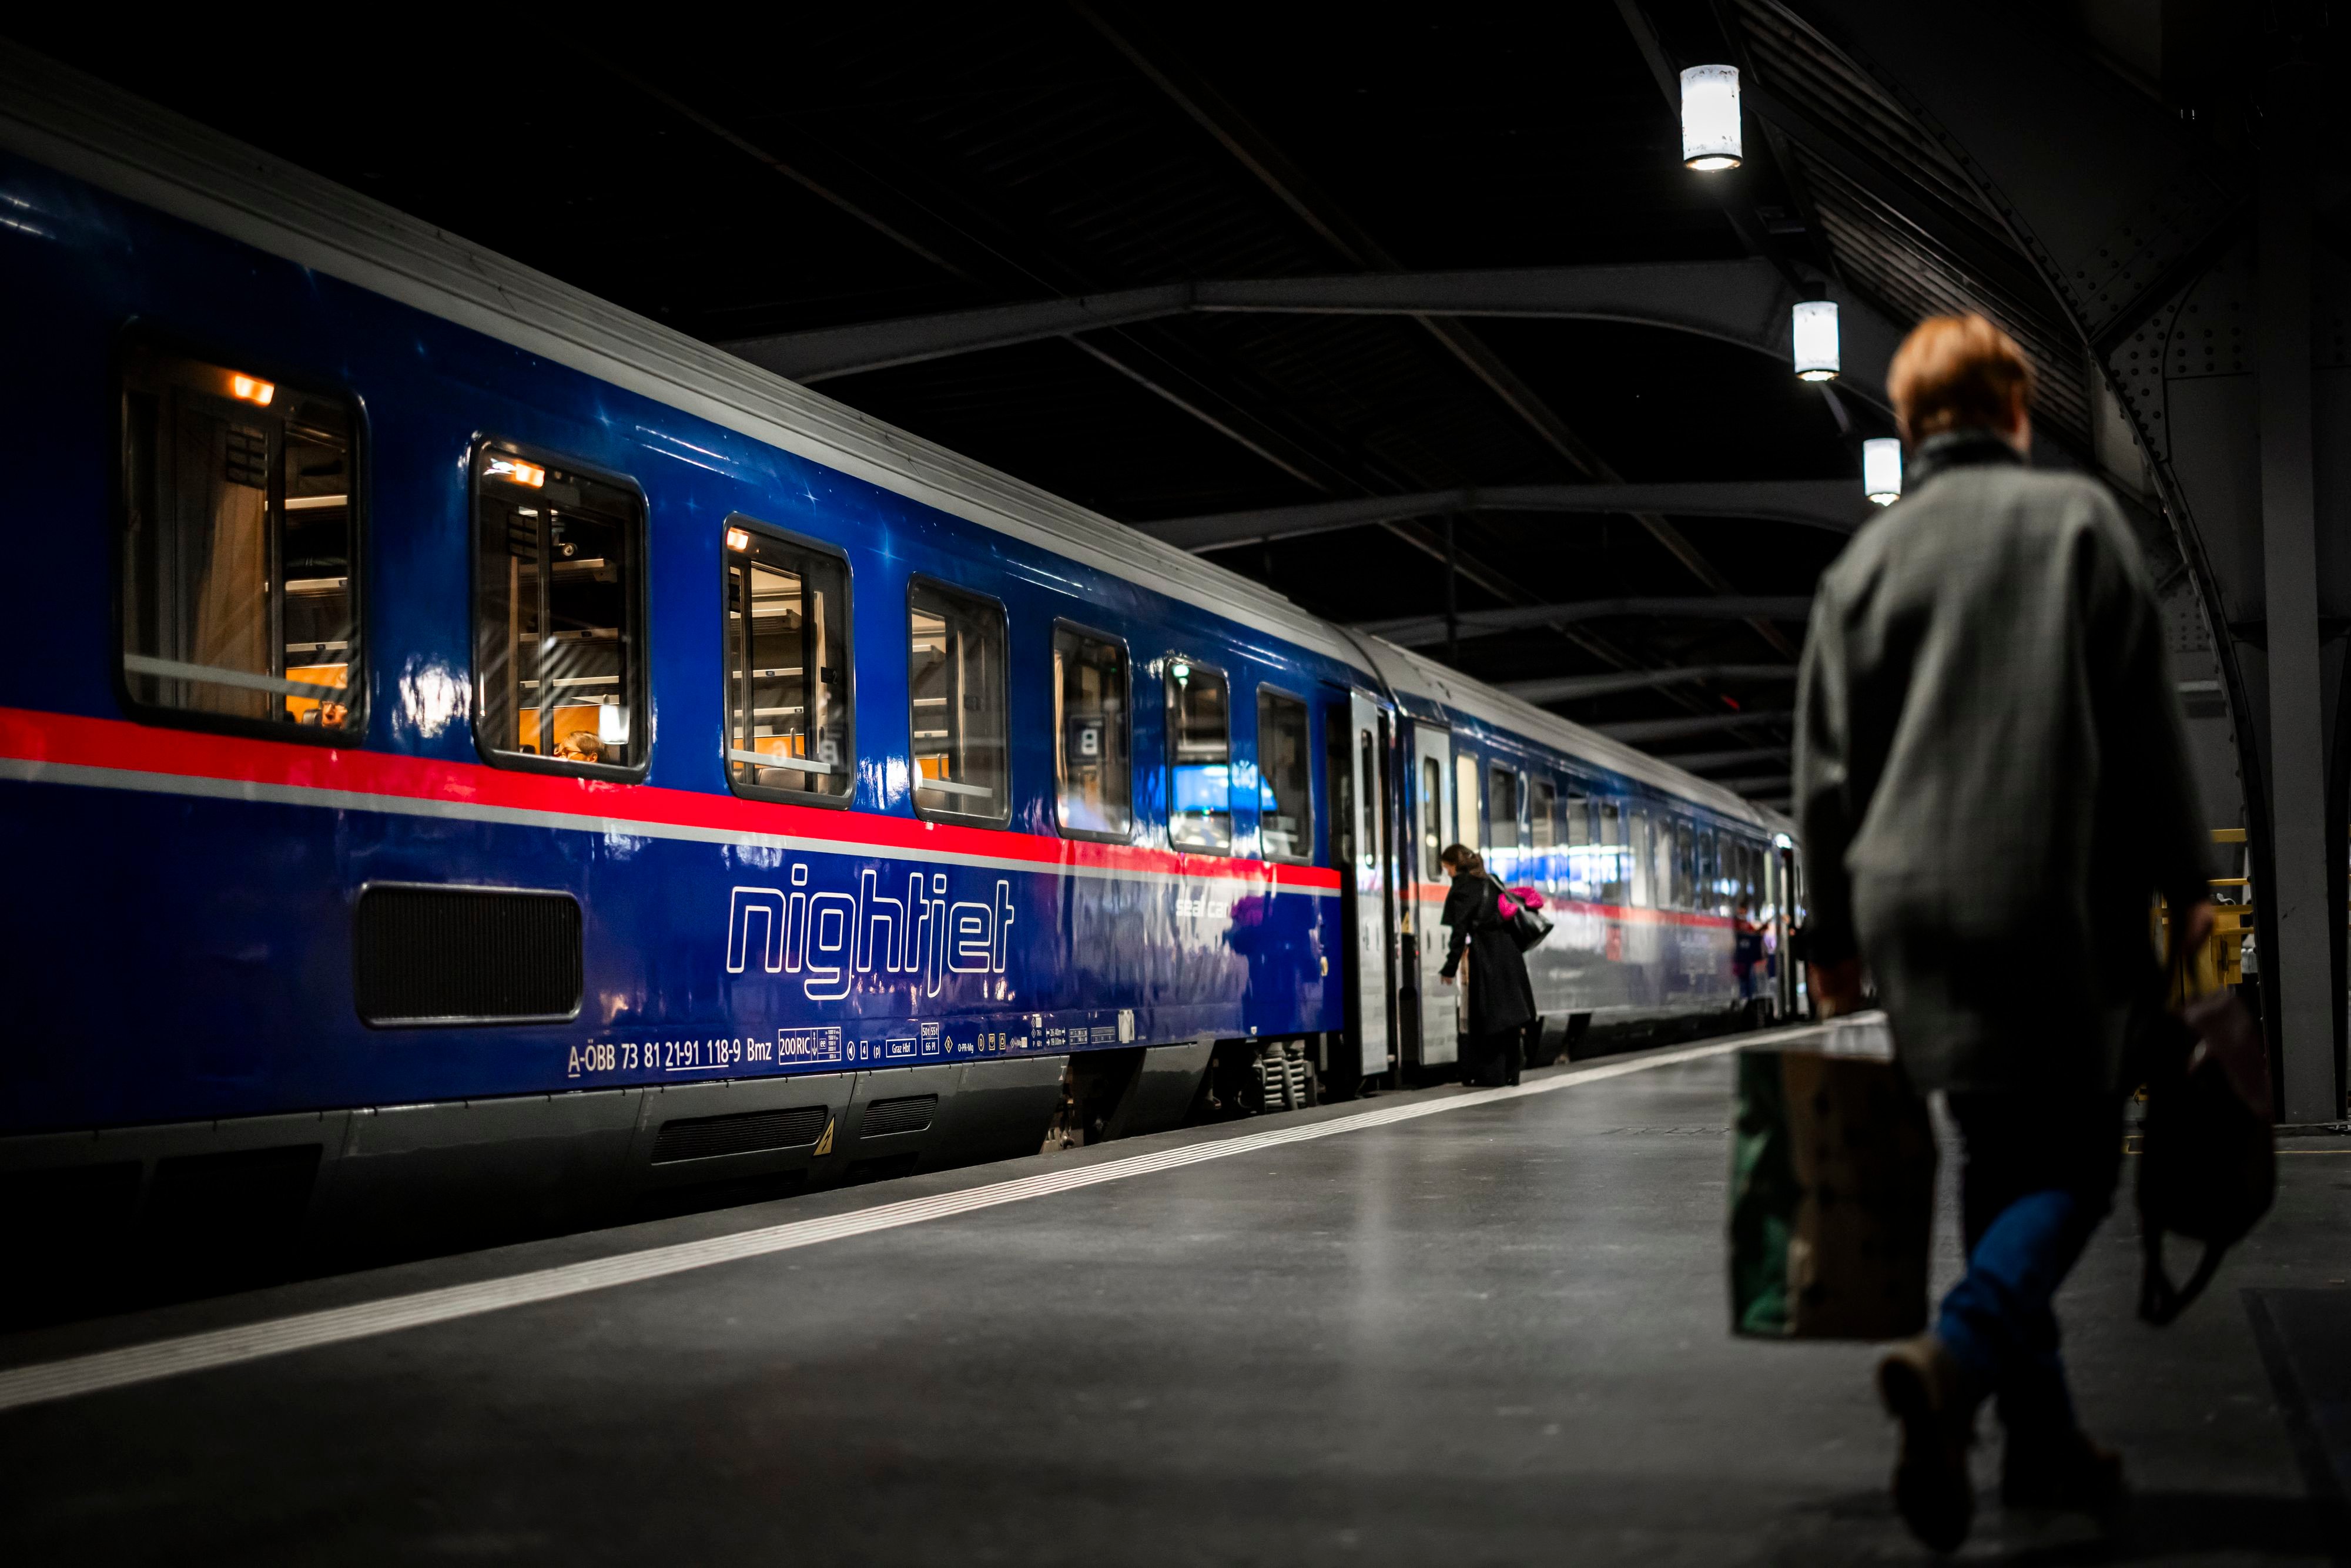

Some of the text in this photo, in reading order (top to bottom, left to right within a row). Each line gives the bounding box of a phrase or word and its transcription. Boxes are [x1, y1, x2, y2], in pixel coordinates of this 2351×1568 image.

[1519, 770, 1529, 833] 2
[726, 863, 1014, 1000] nightjet
[568, 1038, 772, 1073] A-ÖBB 73 81 21-91 118-9 Bmz
[780, 1037, 811, 1056] 200 RIC
[862, 1045, 866, 1055] 4
[892, 1042, 911, 1053] Graz Hbf
[925, 1042, 931, 1051] 66
